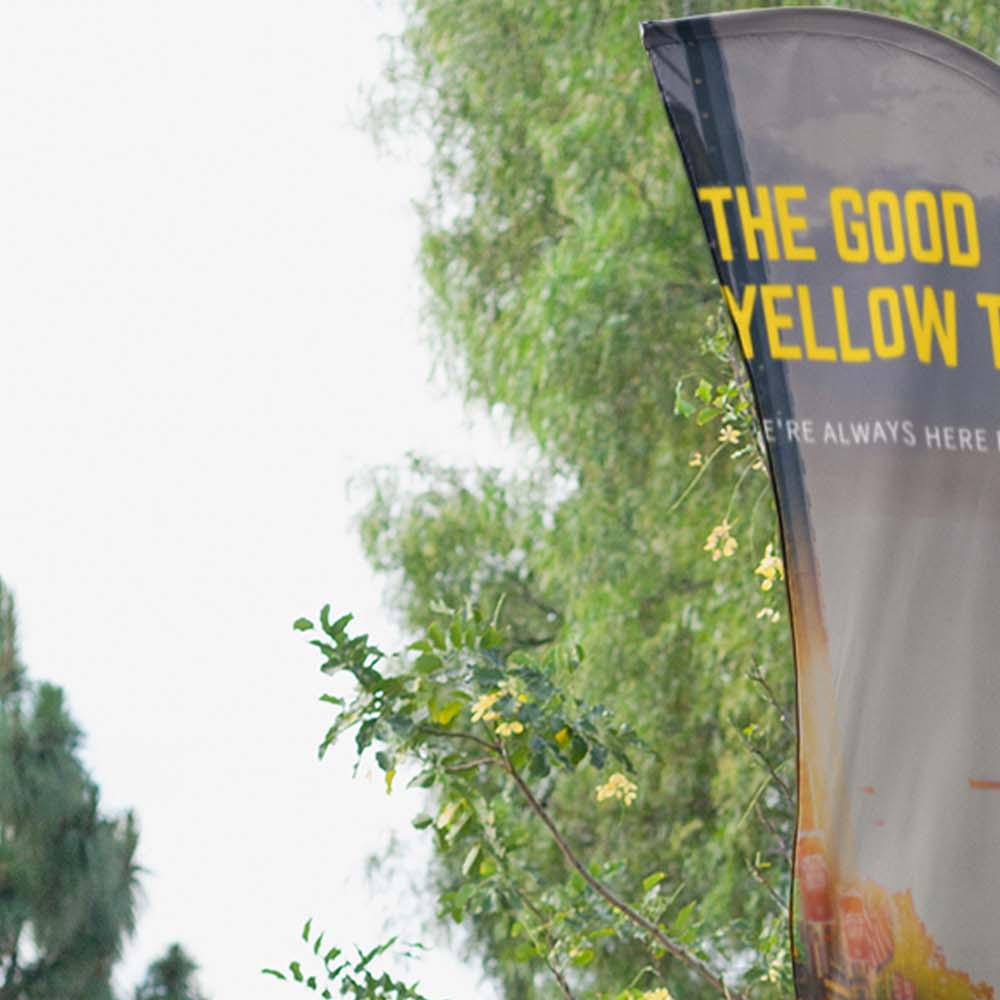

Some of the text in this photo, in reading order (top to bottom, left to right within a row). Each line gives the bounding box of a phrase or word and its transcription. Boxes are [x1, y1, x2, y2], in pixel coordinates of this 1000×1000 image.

[698, 185, 981, 267] THE GOOD
[720, 284, 958, 367] YELLOW
[763, 417, 816, 443] E'RE
[823, 419, 917, 447] ALWAYS
[924, 425, 988, 452] HERE
